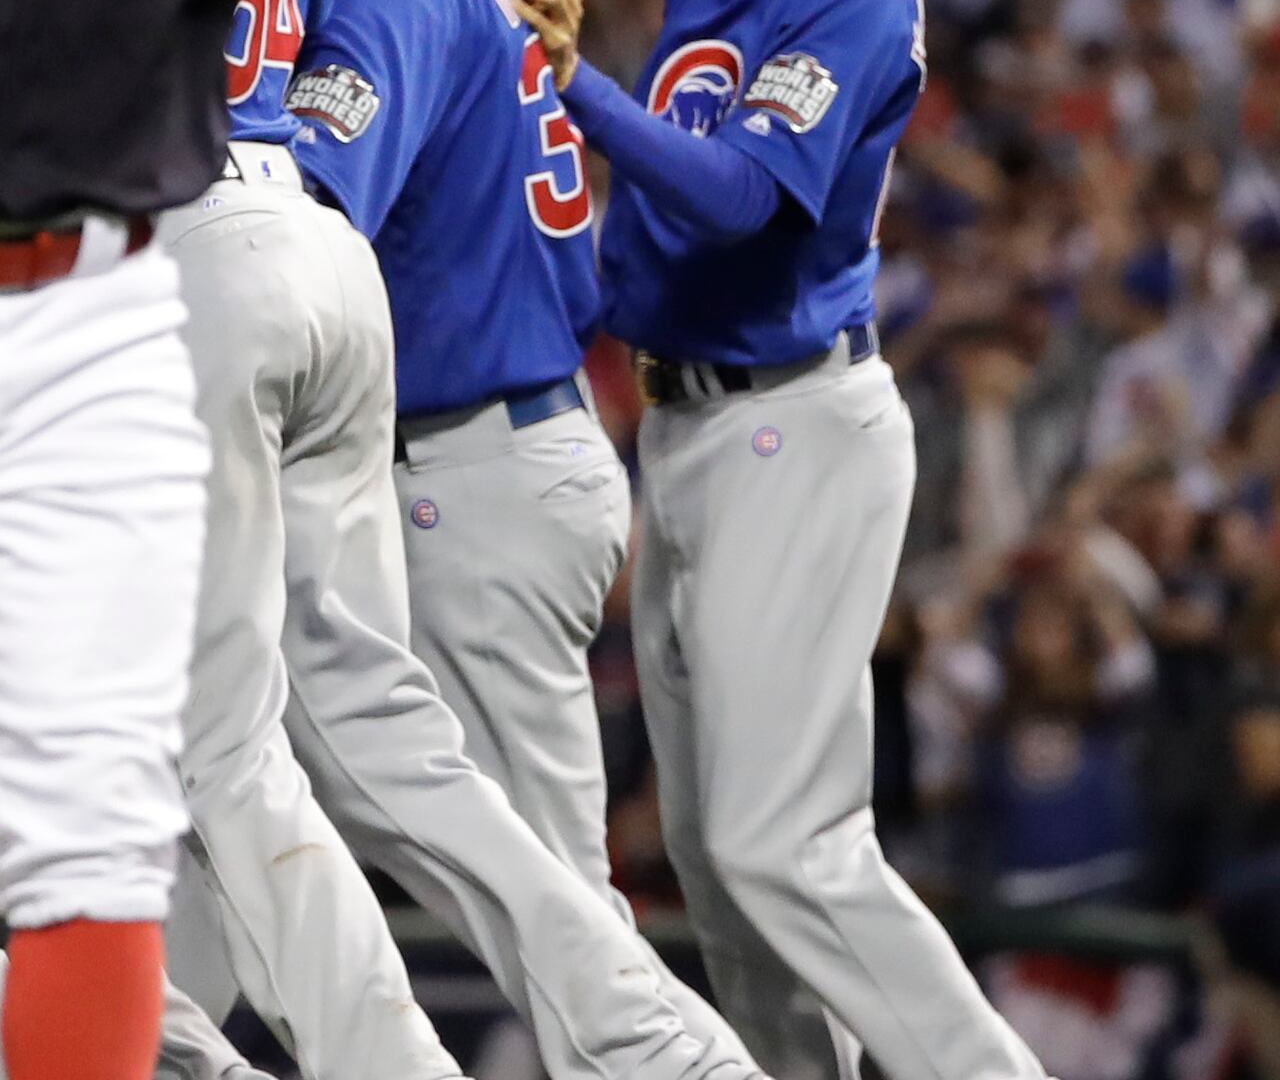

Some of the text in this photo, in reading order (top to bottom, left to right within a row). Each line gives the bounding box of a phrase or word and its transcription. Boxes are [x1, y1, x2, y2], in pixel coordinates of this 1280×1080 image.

[297, 75, 373, 114] WORLD
[743, 79, 821, 124] SERIES
[757, 63, 829, 101] WORLD
[285, 90, 364, 132] SERIES
